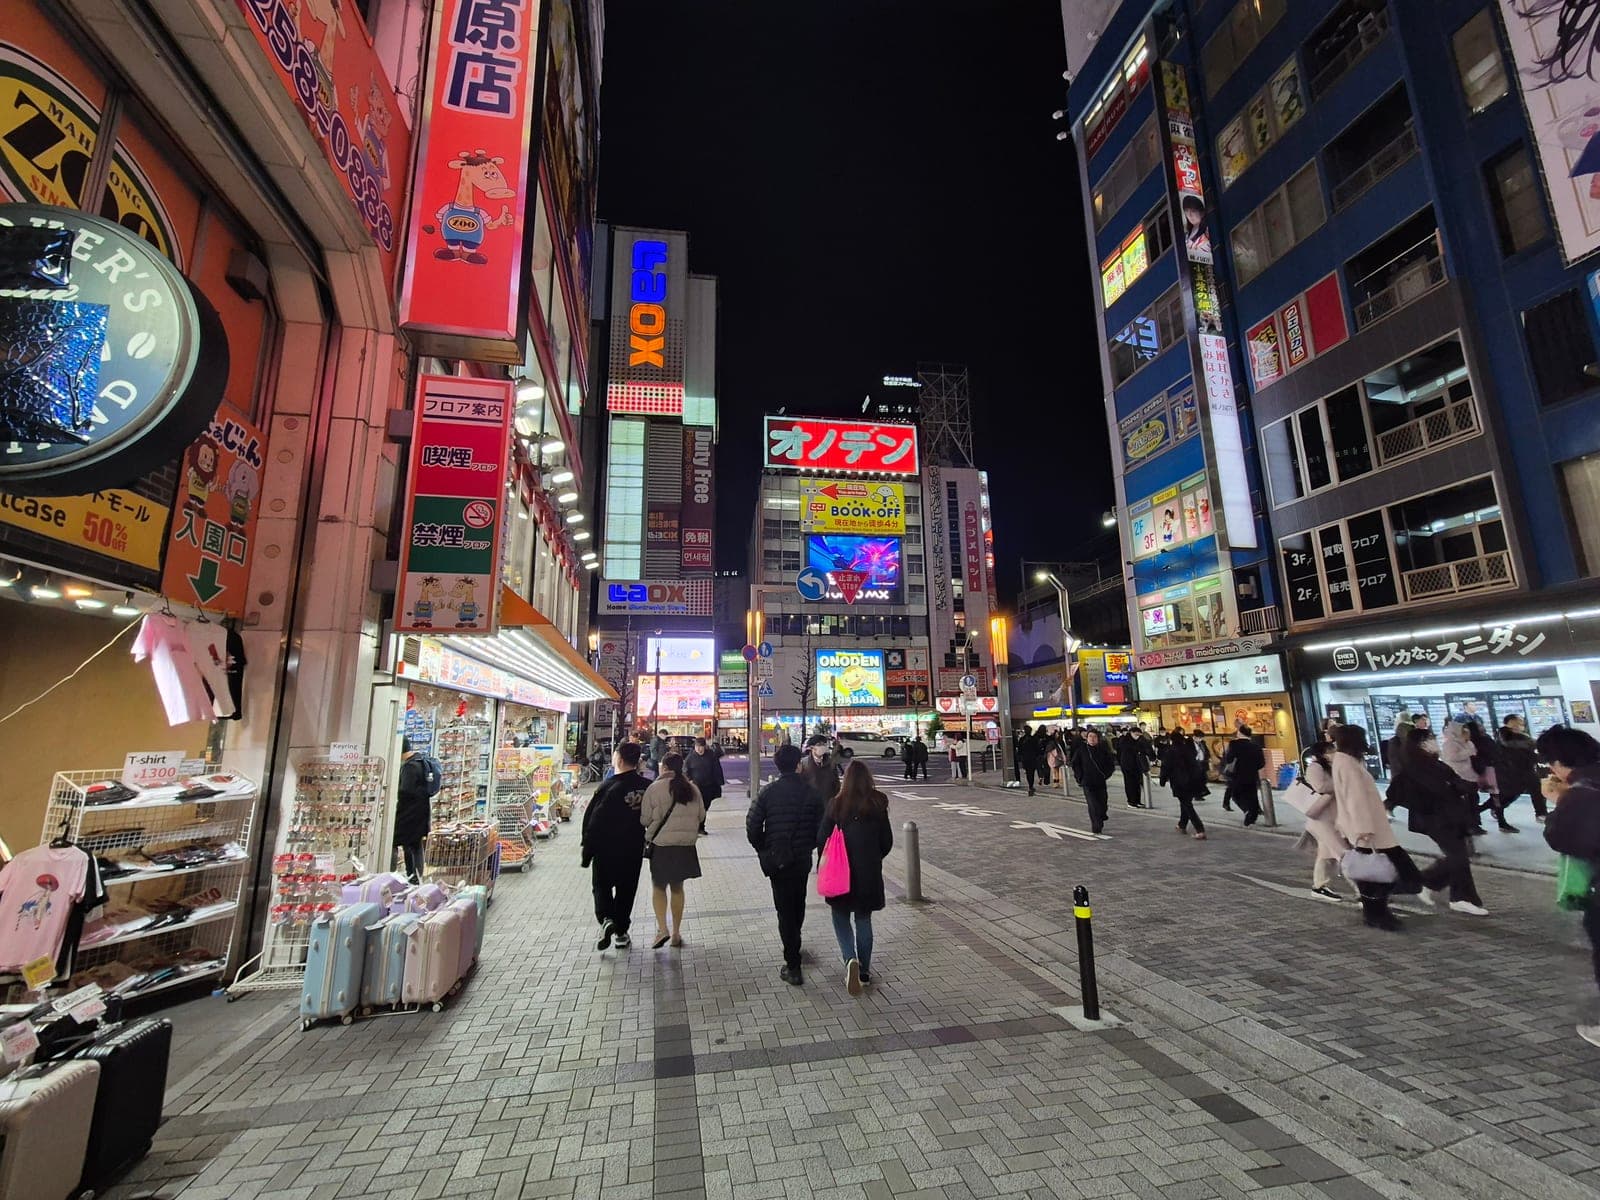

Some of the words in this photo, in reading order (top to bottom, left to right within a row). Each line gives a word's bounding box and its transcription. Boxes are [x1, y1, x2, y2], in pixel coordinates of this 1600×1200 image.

[46, 101, 144, 211] MAHONG
[451, 216, 477, 229] ZOO
[424, 399, 502, 418] フロア案内
[693, 431, 713, 467] Duty
[770, 425, 913, 465] オノデン
[421, 445, 498, 472] 喫煙フロア
[694, 469, 712, 504] Free
[412, 522, 491, 550] 禁煙フロア
[1134, 519, 1144, 537] 2F
[176, 509, 248, 566] 入園口
[1144, 532, 1155, 550] 3F
[1290, 553, 1306, 567] 3F
[865, 590, 889, 600] MX
[1296, 587, 1313, 601] 2F
[1195, 641, 1240, 658] maidreamin
[1365, 623, 1546, 671] トレカならスニダン
[819, 655, 881, 667] ONODEN
[1254, 664, 1268, 675] 24
[129, 754, 168, 765] T-shirt
